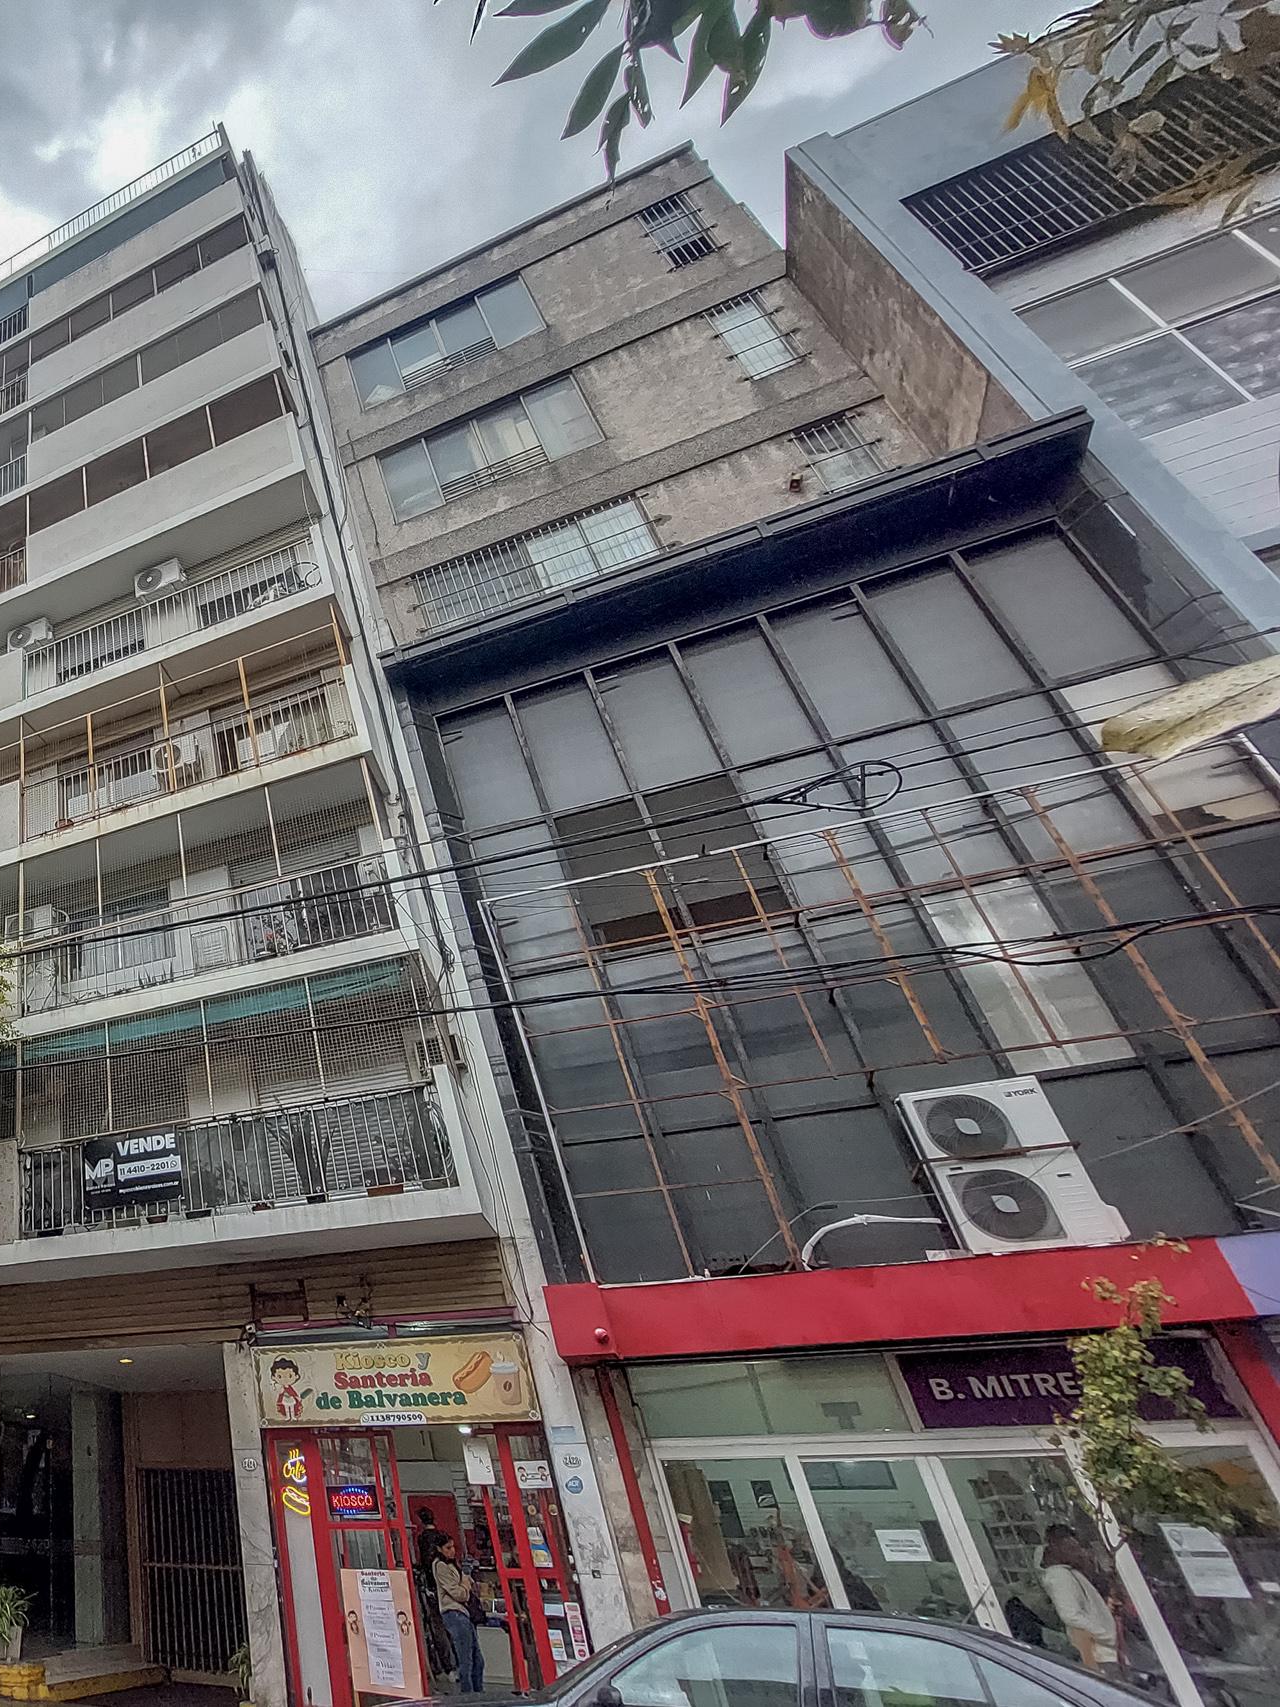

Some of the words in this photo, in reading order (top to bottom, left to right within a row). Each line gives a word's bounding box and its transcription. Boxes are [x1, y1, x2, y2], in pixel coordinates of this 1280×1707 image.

[1011, 1088, 1037, 1096] YORK
[116, 1133, 176, 1156] VENDE
[126, 1160, 169, 1174] 4410-2201
[334, 1352, 411, 1370] Kiosco
[415, 1352, 431, 1370] y
[928, 1378, 966, 1400] B.
[967, 1372, 1081, 1399] MITRE
[316, 1391, 343, 1410] de
[347, 1390, 468, 1409] Balvanera
[369, 1413, 423, 1422] 1138790509
[332, 1495, 373, 1506] KIOSCO
